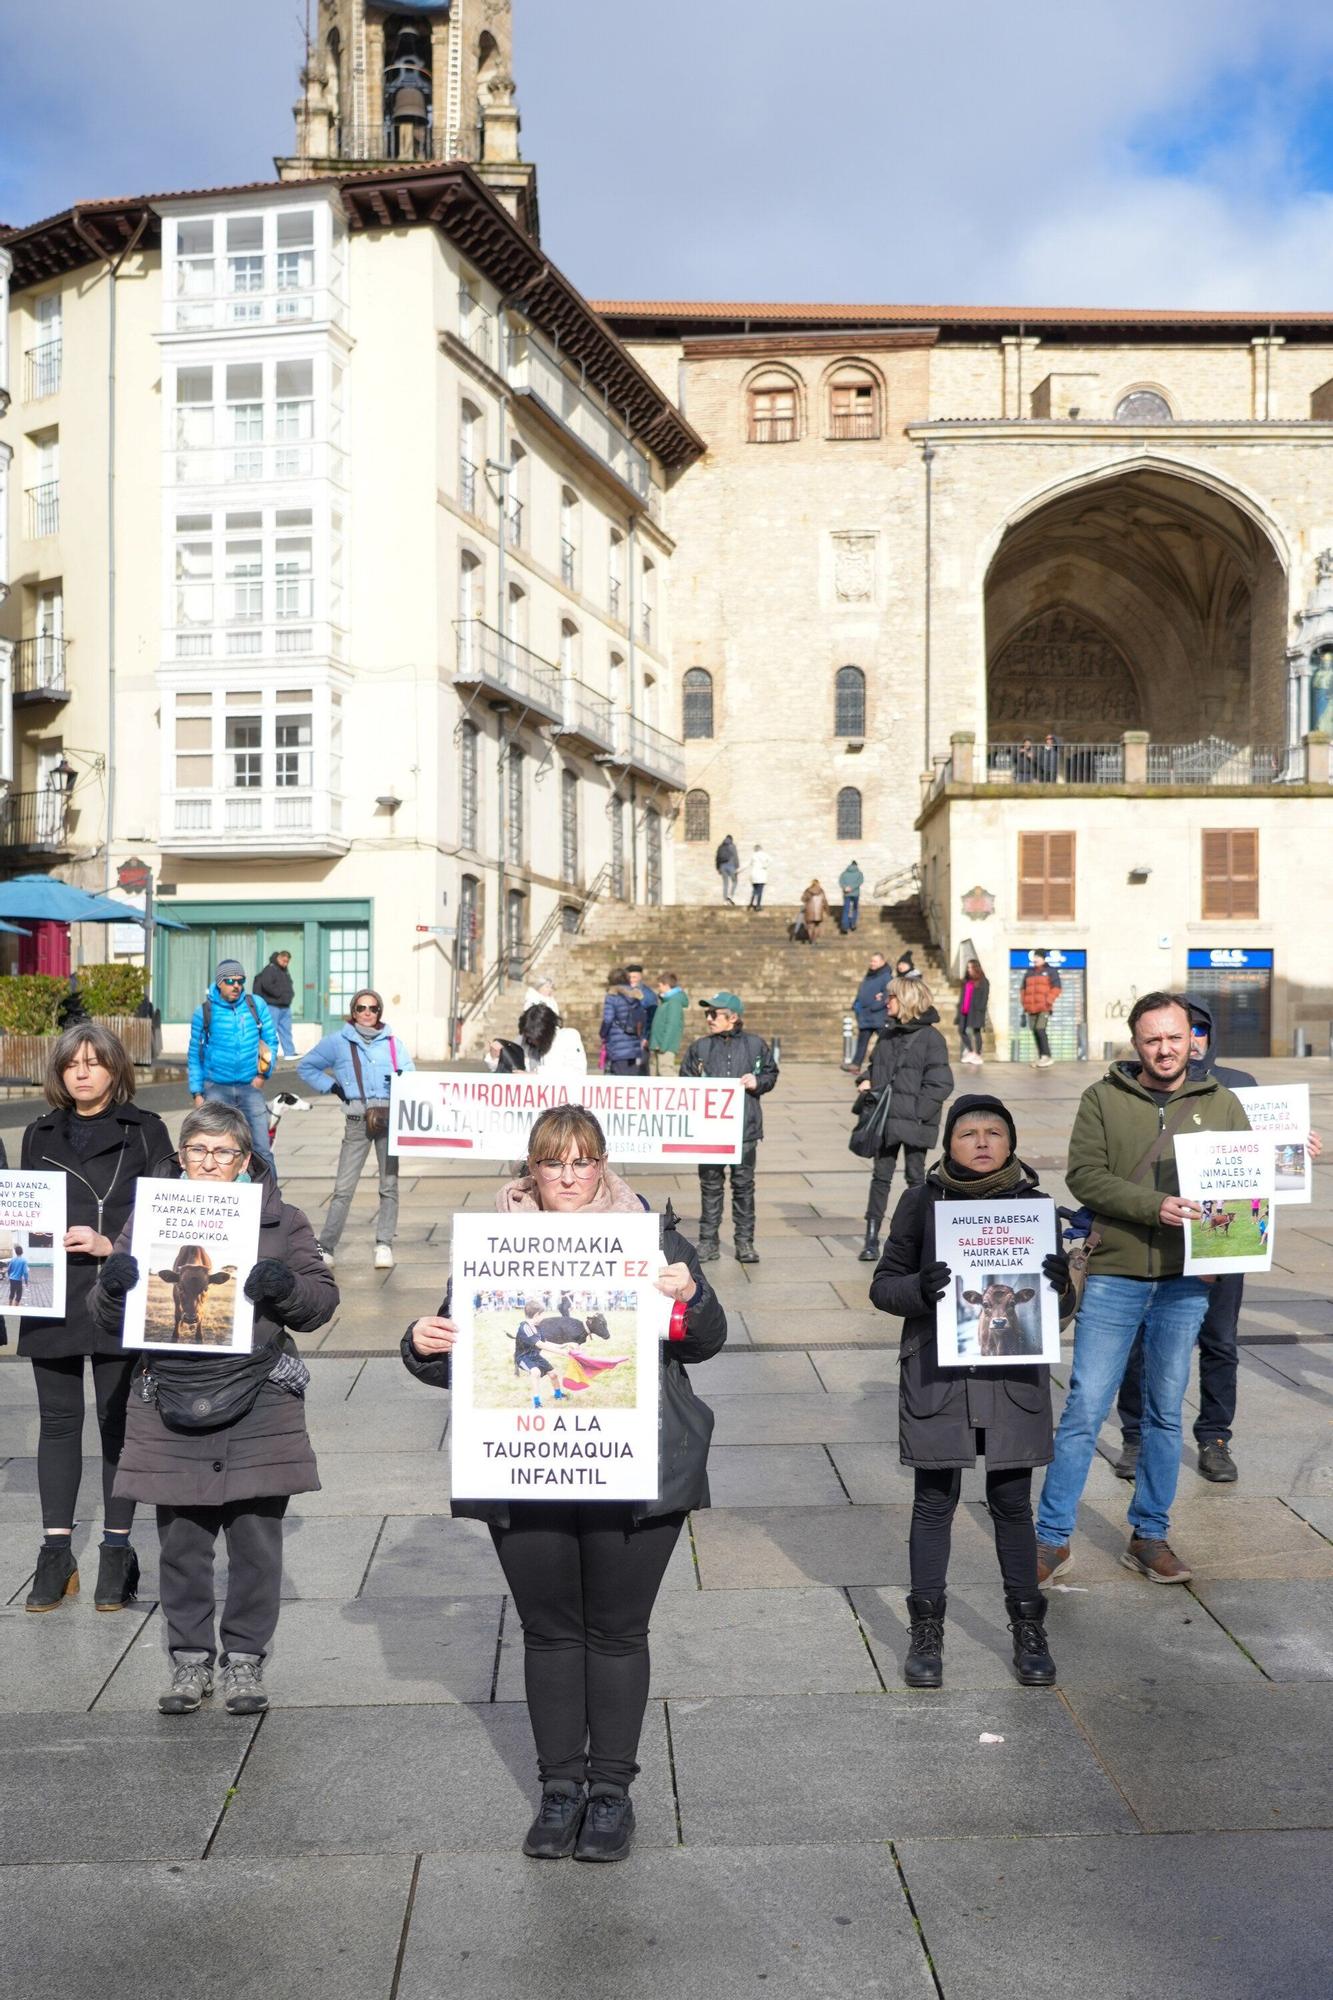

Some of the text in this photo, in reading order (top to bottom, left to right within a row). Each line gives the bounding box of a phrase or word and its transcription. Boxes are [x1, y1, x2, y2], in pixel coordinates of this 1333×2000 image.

[439, 1082, 735, 1120] TAUROMAKIA UMEENTZAT EZ
[397, 1099, 433, 1132] NO
[451, 1109, 534, 1133] TAUROM
[607, 1113, 694, 1138] INFANTIL
[1215, 1156, 1243, 1165] A LOS
[1199, 1167, 1246, 1177] NIMALES
[0, 1181, 51, 1190] ADI AVANZA,
[1200, 1179, 1259, 1190] LA INFANCIA
[19, 1191, 36, 1199] PSE
[154, 1193, 240, 1205] ANIMALIEI TRATU
[0, 1200, 43, 1208] ROCEDEN:
[12, 1210, 23, 1218] LA
[26, 1210, 41, 1218] LEY
[152, 1204, 241, 1217] TXARRAK EMATEA
[166, 1218, 178, 1226] EZ
[181, 1219, 194, 1227] DA
[952, 1215, 1040, 1225] AHULEN BABESAK
[982, 1226, 1010, 1235] EZ DU
[487, 1237, 624, 1253] TAUROMAKIA
[958, 1236, 1034, 1247] SALBUESPENIK:
[963, 1247, 1030, 1257] HAURRAK ETA
[970, 1258, 1023, 1268] ANIMALIAK
[463, 1260, 649, 1277] HAURRENTZAT EZ
[516, 1415, 601, 1432] NO A LA
[483, 1441, 634, 1458] TAUROMAQUIA
[511, 1468, 607, 1485] INFANTIL
